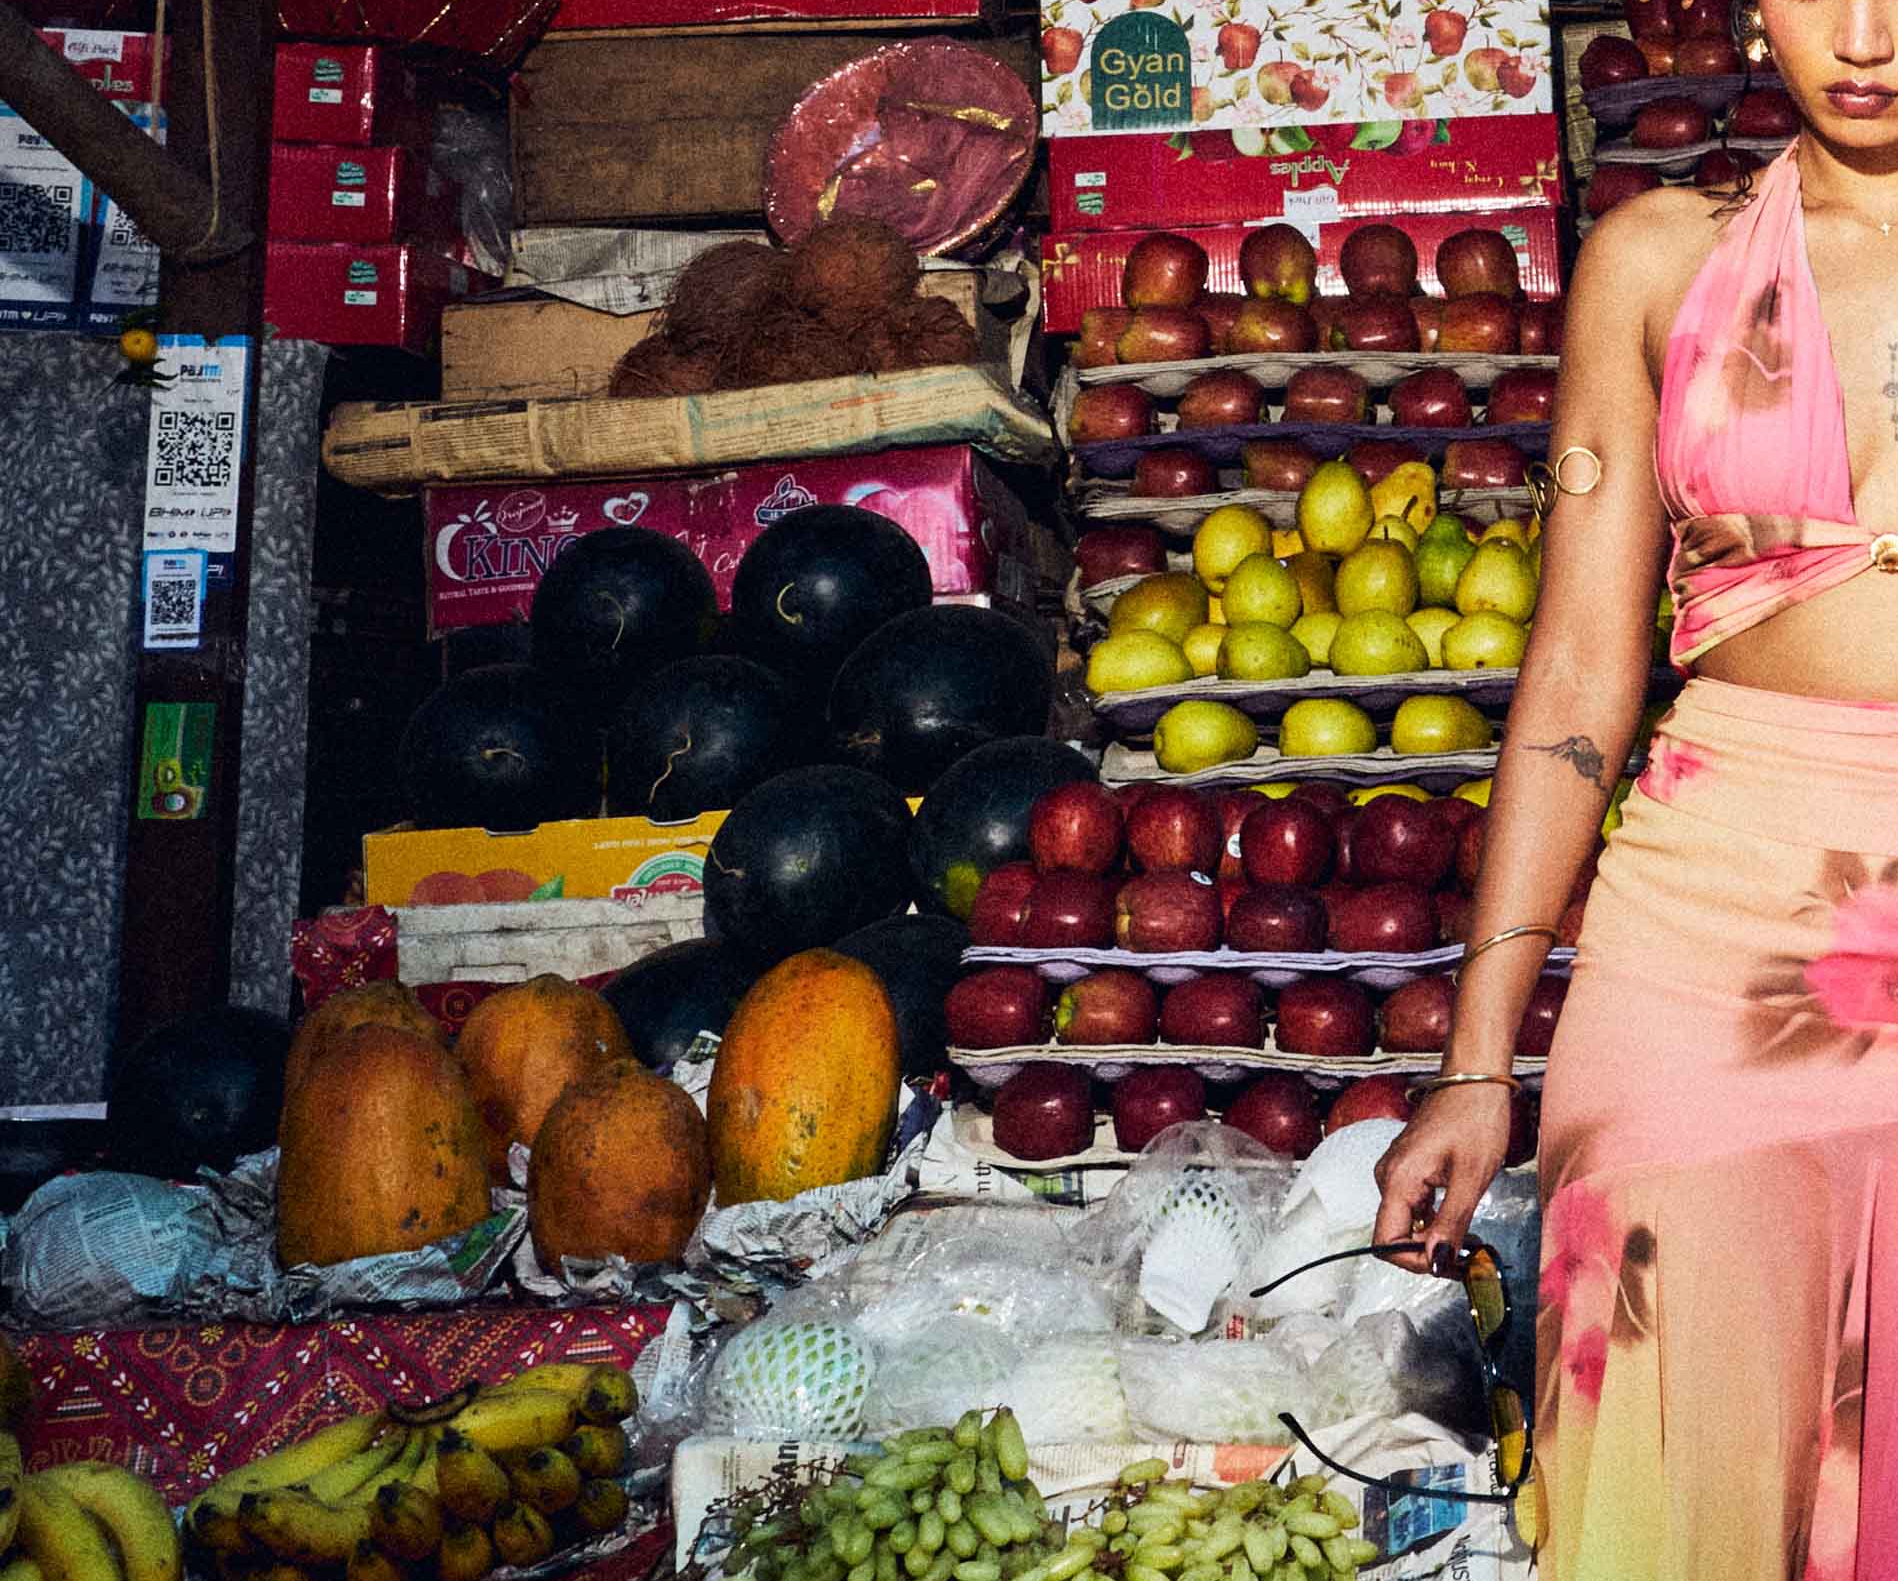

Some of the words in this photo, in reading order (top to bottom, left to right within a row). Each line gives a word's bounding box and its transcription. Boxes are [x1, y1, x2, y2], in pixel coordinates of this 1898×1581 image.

[1100, 48, 1184, 80] Gyan
[1104, 82, 1182, 111] Gold
[1270, 155, 1351, 187] Apples
[468, 586, 489, 597] TASTE
